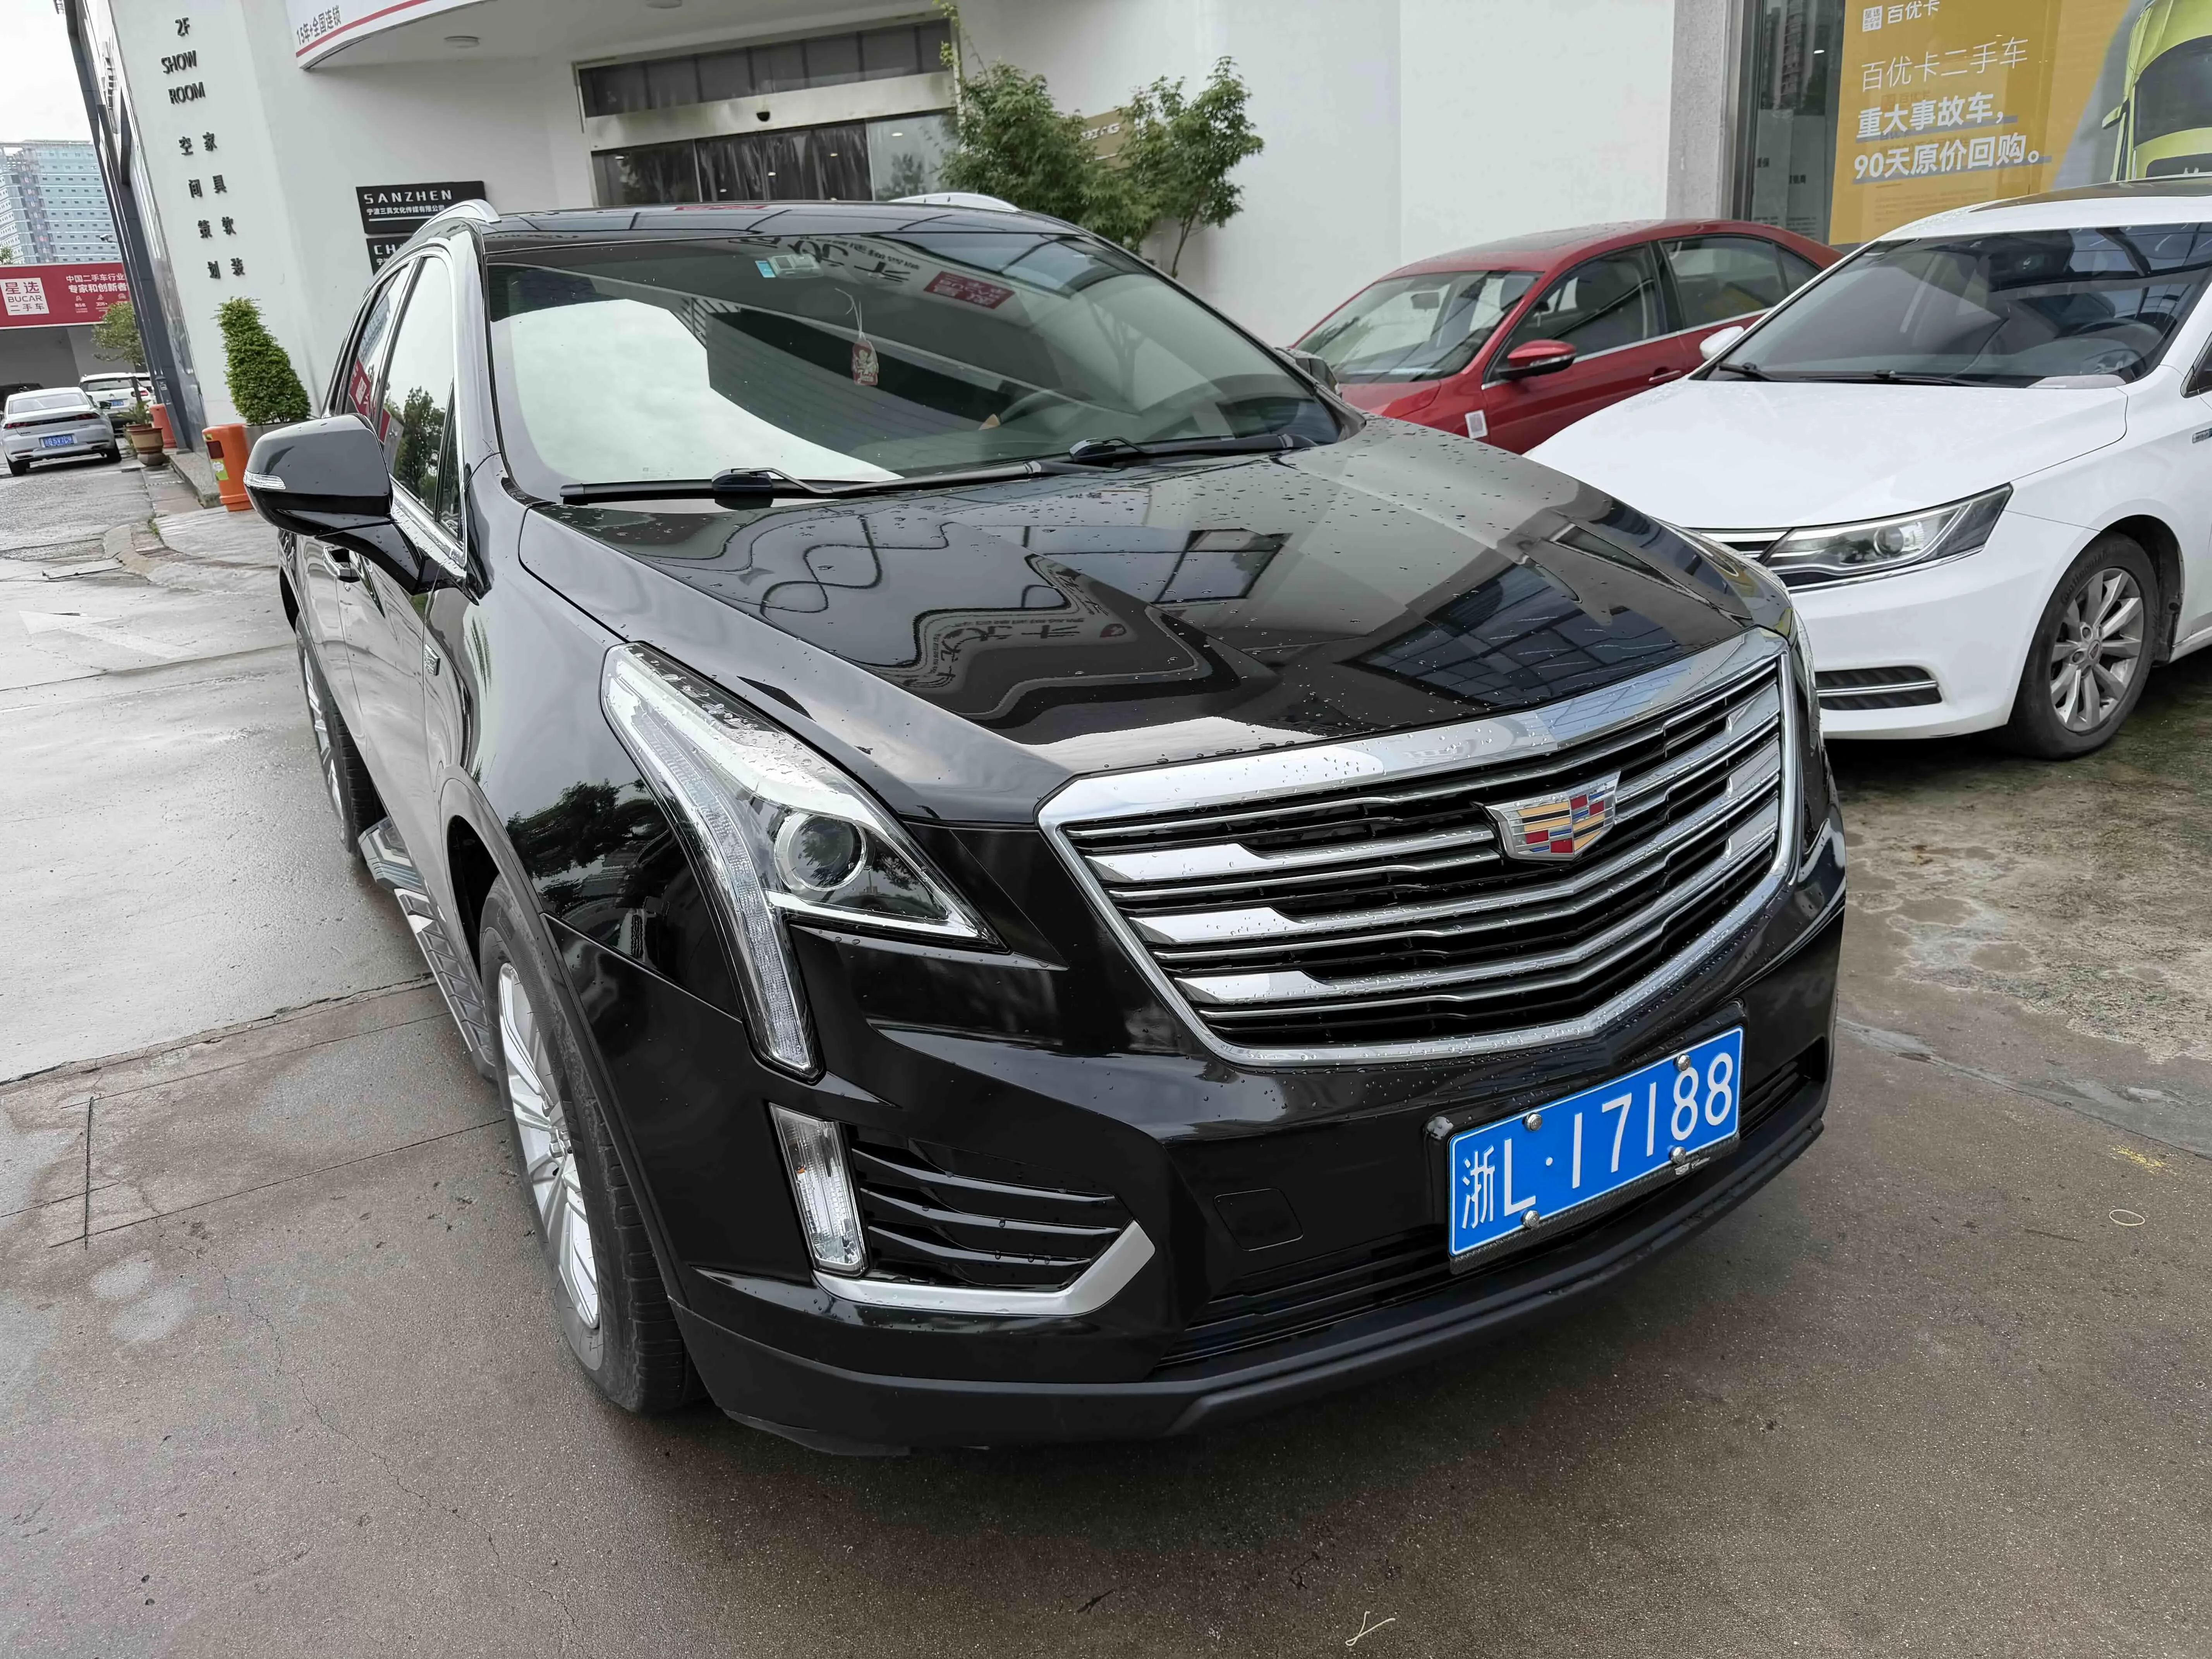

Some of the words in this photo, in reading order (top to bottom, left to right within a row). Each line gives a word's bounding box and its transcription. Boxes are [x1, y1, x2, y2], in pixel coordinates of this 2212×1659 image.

[1887, 0, 1939, 24] 百优卡
[175, 17, 190, 36] 2F
[297, 5, 341, 46] 15年+全国连锁
[161, 50, 197, 74] SHOW
[1861, 37, 2028, 93] 百优卡二手车
[168, 82, 206, 105] ROOM
[1856, 91, 2003, 138] 重大事故车，
[1854, 132, 2039, 179] 90天原价回购。
[363, 190, 452, 204] SANZHEN
[373, 242, 404, 255] CH
[5, 281, 40, 295] 星选
[65, 273, 126, 283] 中国二手车行业
[68, 283, 128, 294] 专家和创新者
[10, 303, 45, 311] 二手车
